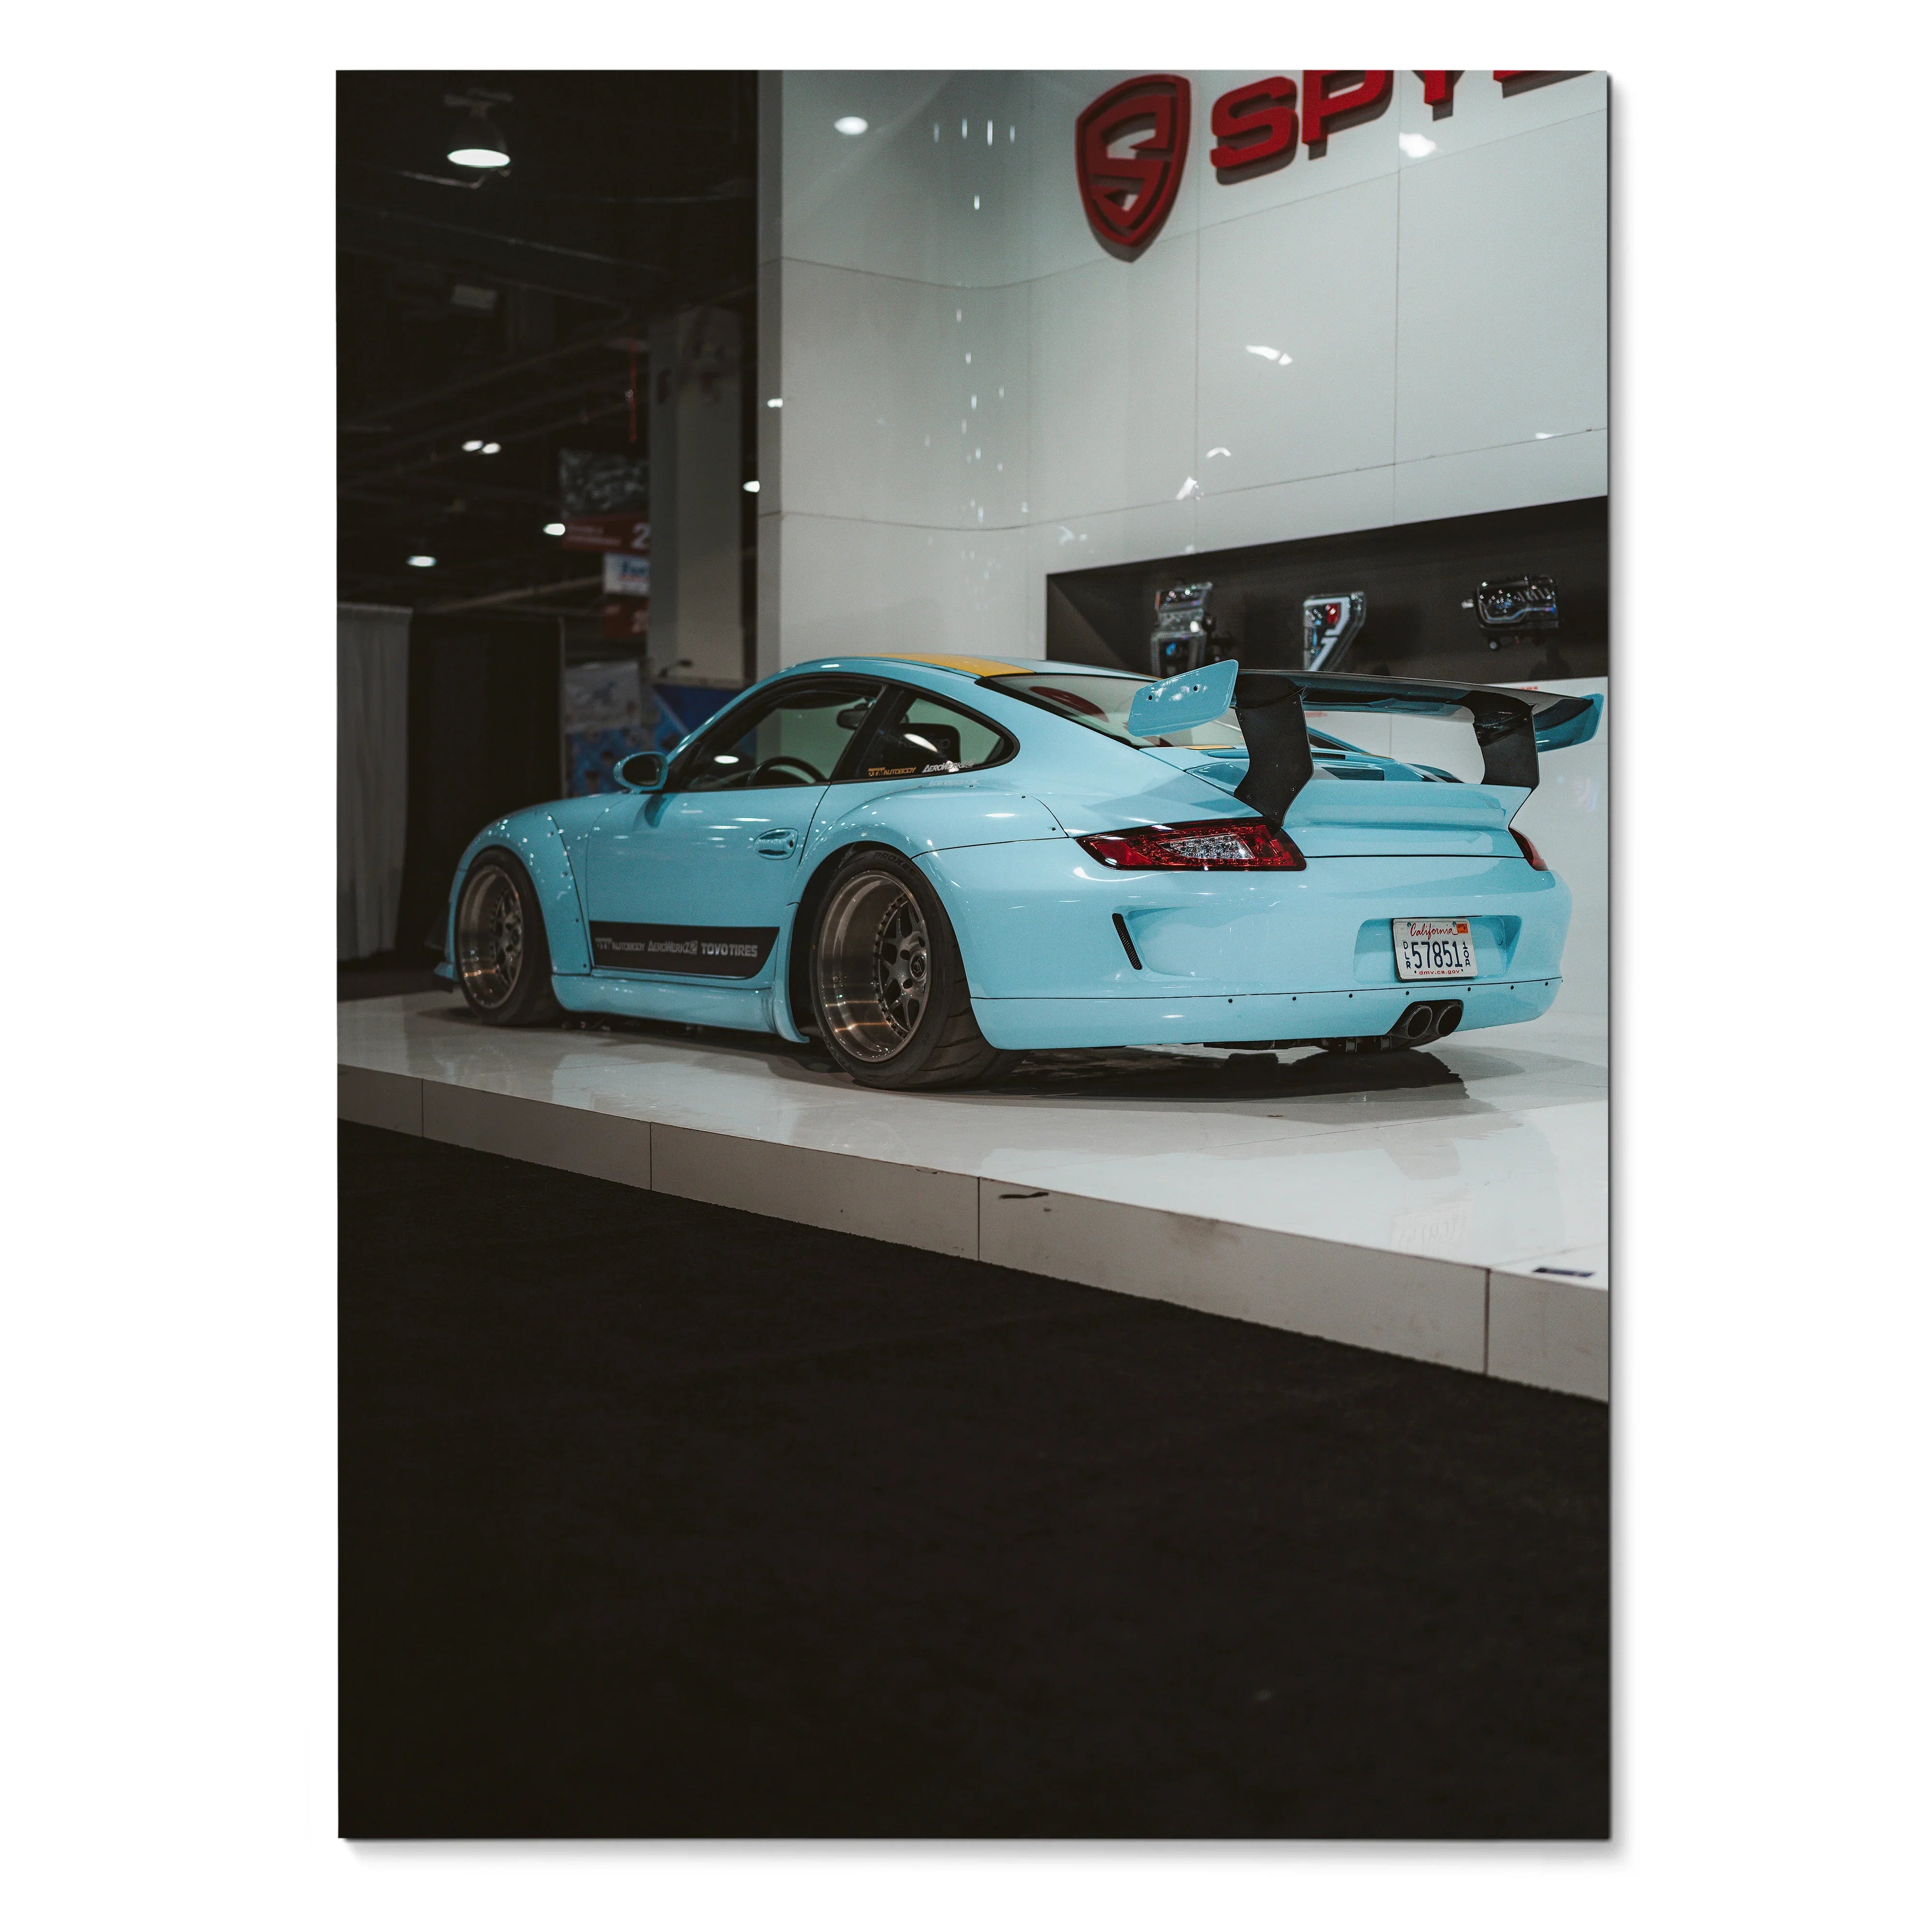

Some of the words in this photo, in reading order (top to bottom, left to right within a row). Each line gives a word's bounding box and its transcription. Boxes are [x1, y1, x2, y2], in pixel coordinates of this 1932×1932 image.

[874, 852, 918, 875] PROXES
[1410, 923, 1458, 940] California
[701, 943, 728, 955] TOYO
[729, 944, 758, 957] TIRES
[1403, 941, 1411, 969] DLR
[1411, 941, 1463, 969] 57851
